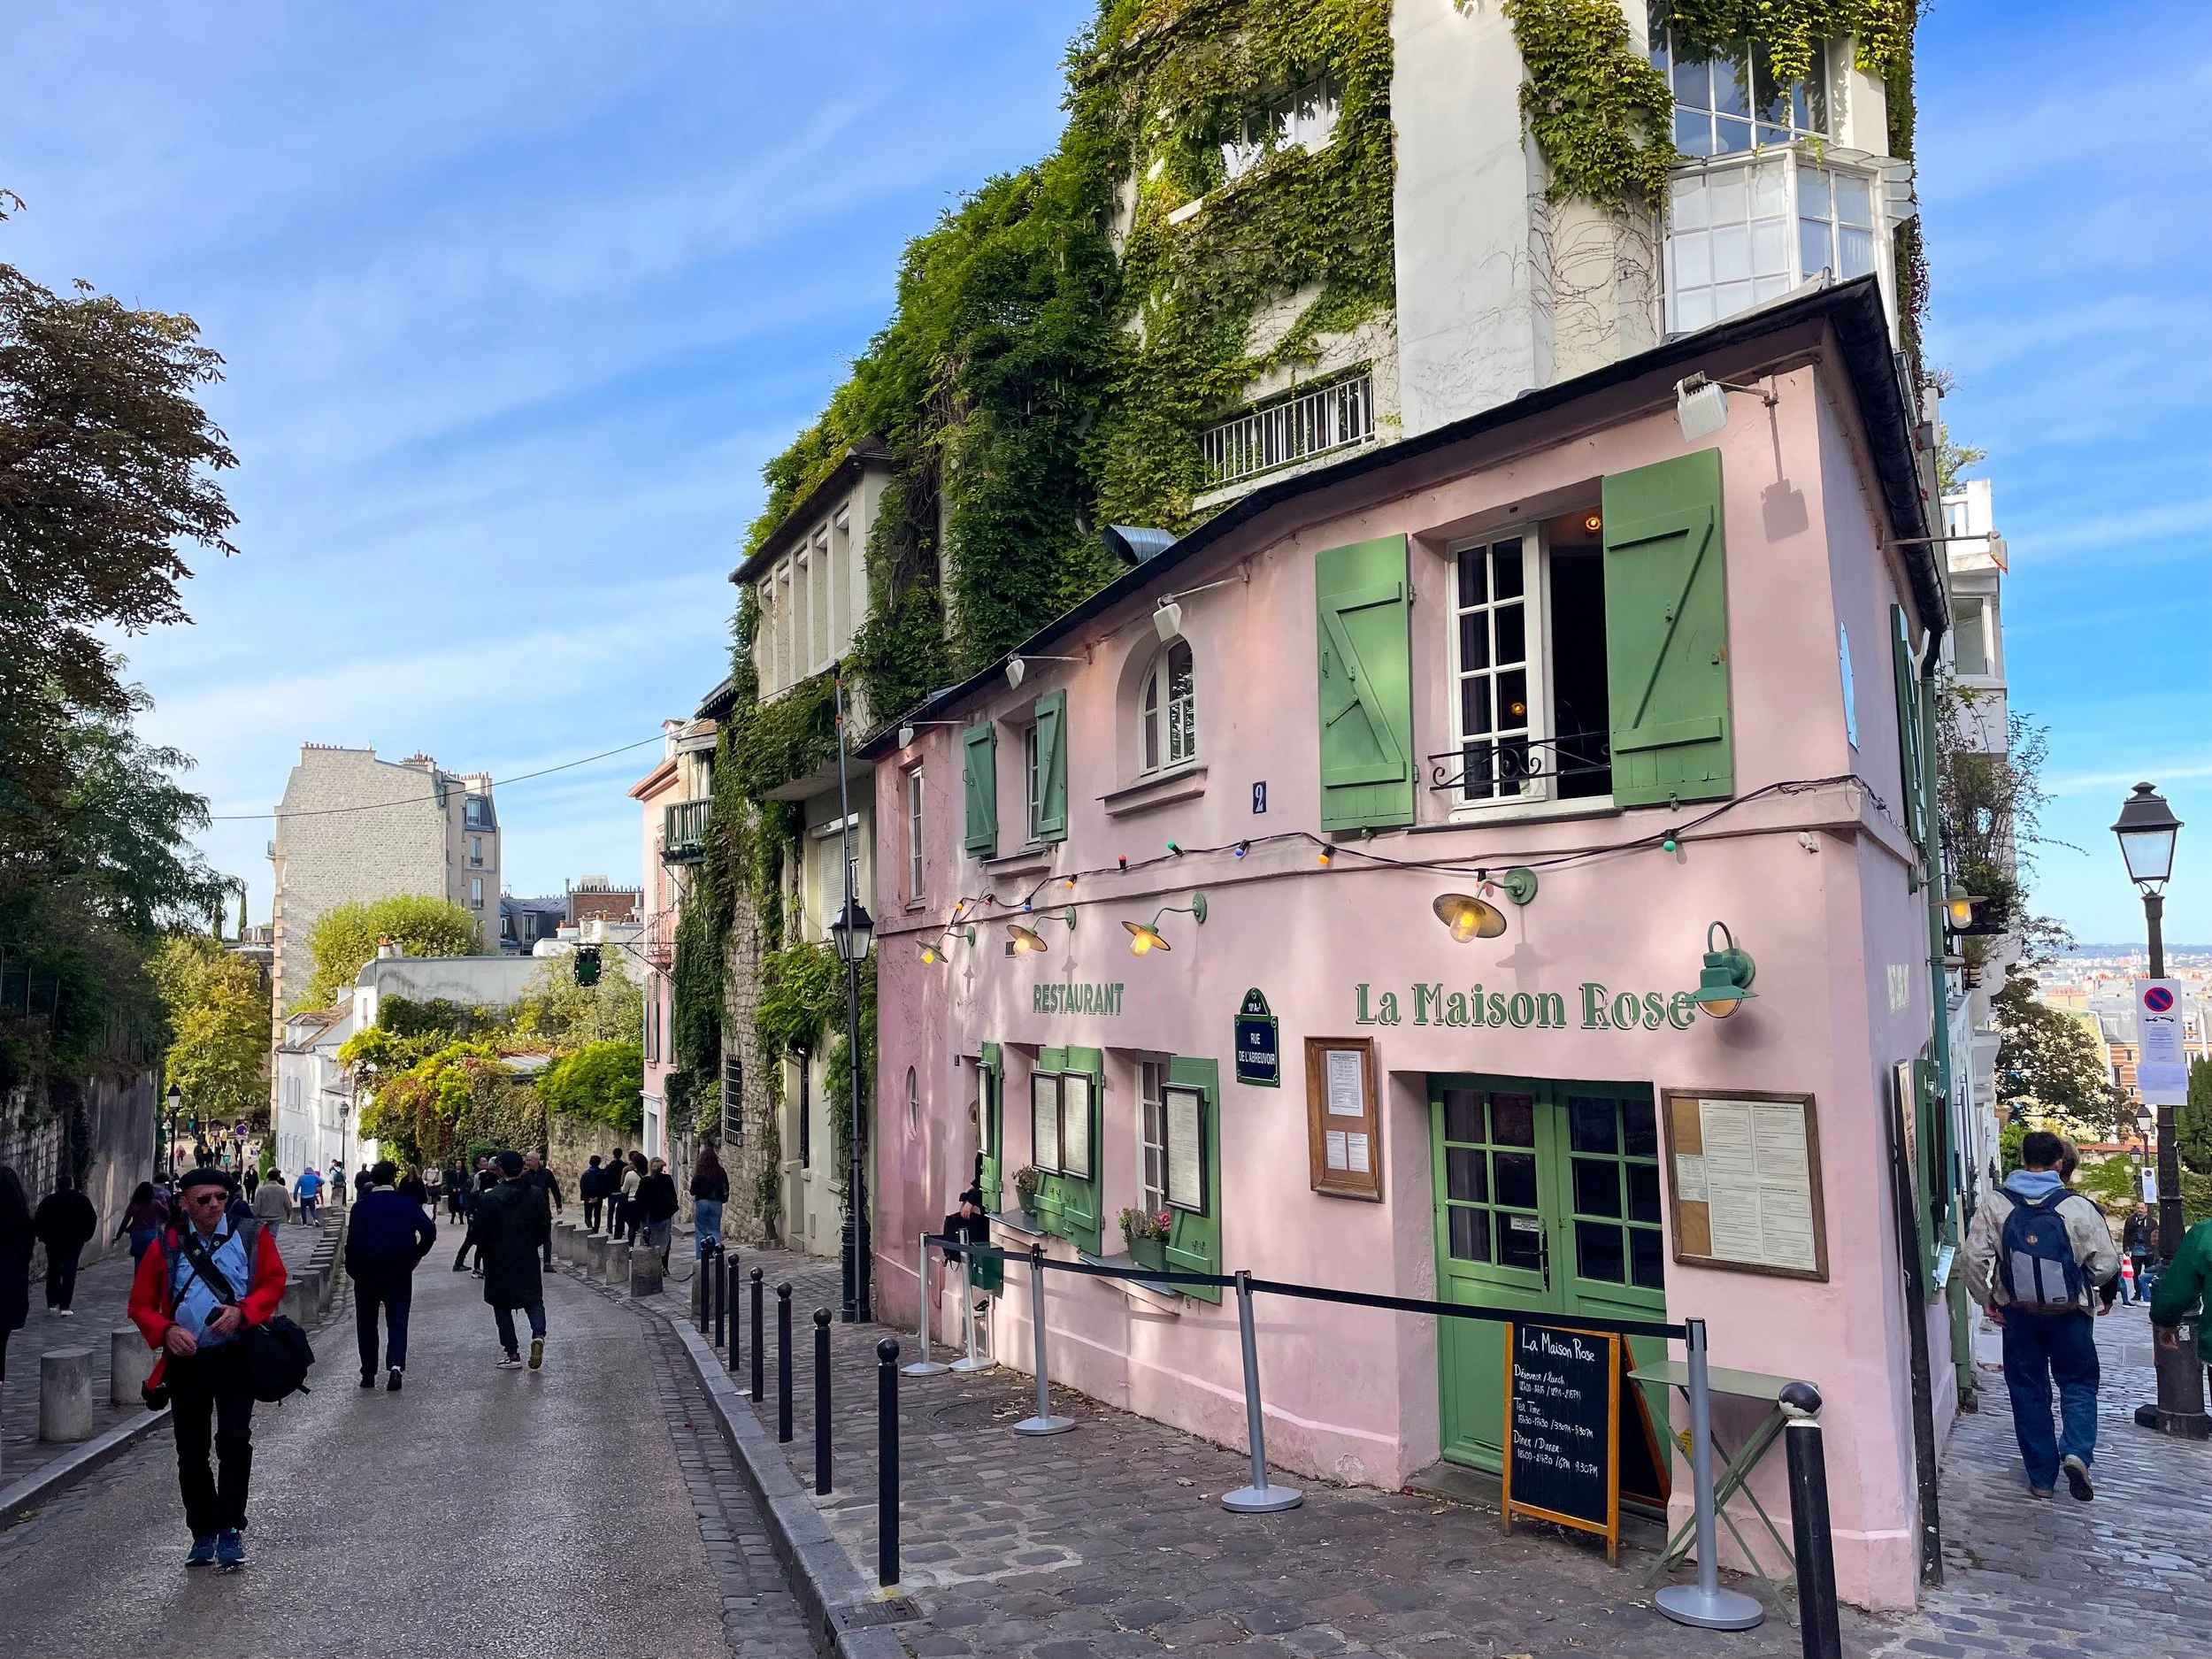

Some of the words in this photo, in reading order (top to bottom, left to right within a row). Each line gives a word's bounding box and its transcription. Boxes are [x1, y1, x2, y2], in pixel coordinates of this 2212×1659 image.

[1033, 983, 1125, 1016] RESTAURANT
[1355, 982, 1402, 1026] La
[1411, 982, 1566, 1028] Maison
[1578, 981, 1696, 1030] Rose
[1250, 1033, 1261, 1045] RUE
[1238, 1050, 1245, 1062] DE
[1245, 1051, 1276, 1065] L'ABREUVOIR
[1522, 1327, 1538, 1352] La
[1541, 1332, 1572, 1359] Maison
[1572, 1338, 1595, 1362] Rose
[1512, 1397, 1526, 1412] Tea
[1527, 1401, 1541, 1415] Time
